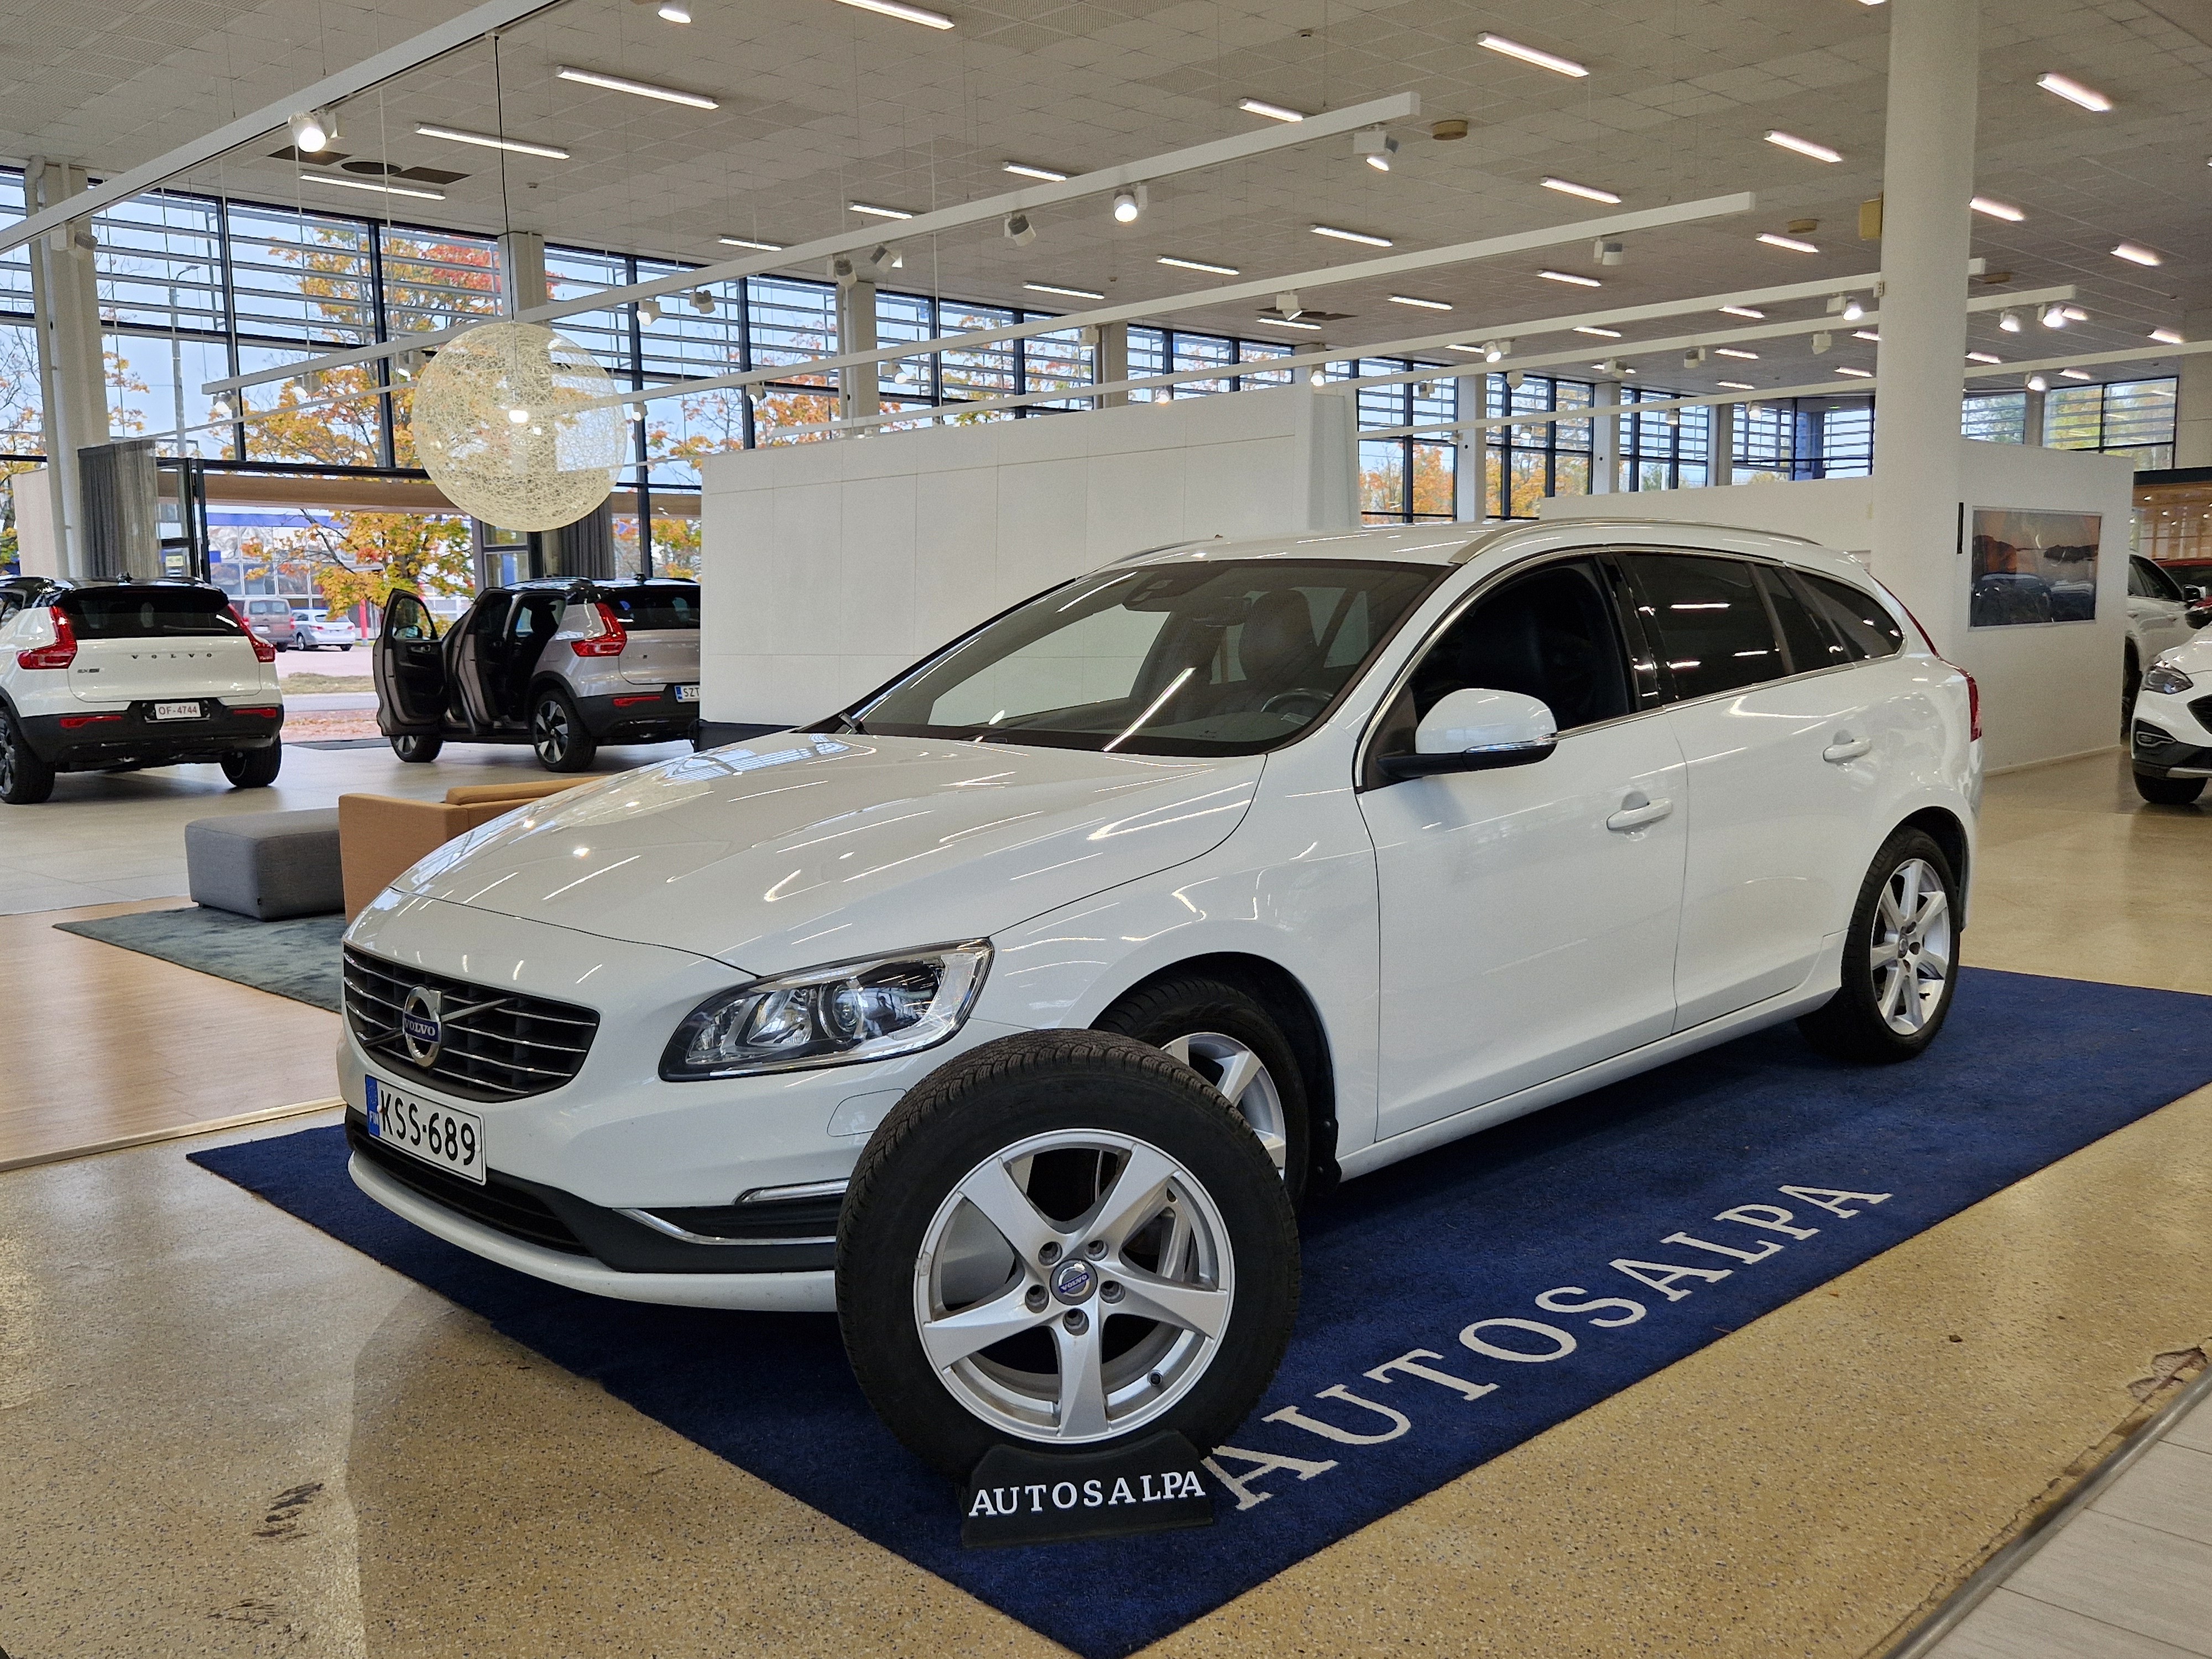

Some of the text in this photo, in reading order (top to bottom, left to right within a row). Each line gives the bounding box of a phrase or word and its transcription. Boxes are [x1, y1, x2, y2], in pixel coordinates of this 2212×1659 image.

[158, 705, 198, 715] OF-4744
[404, 1018, 436, 1036] VOLVO
[380, 1089, 476, 1166] KSS-689
[1060, 1274, 1087, 1291] VOLVO
[1201, 1184, 1892, 1511] AUTOSALPA
[968, 1470, 1206, 1517] AUTOSALPA
